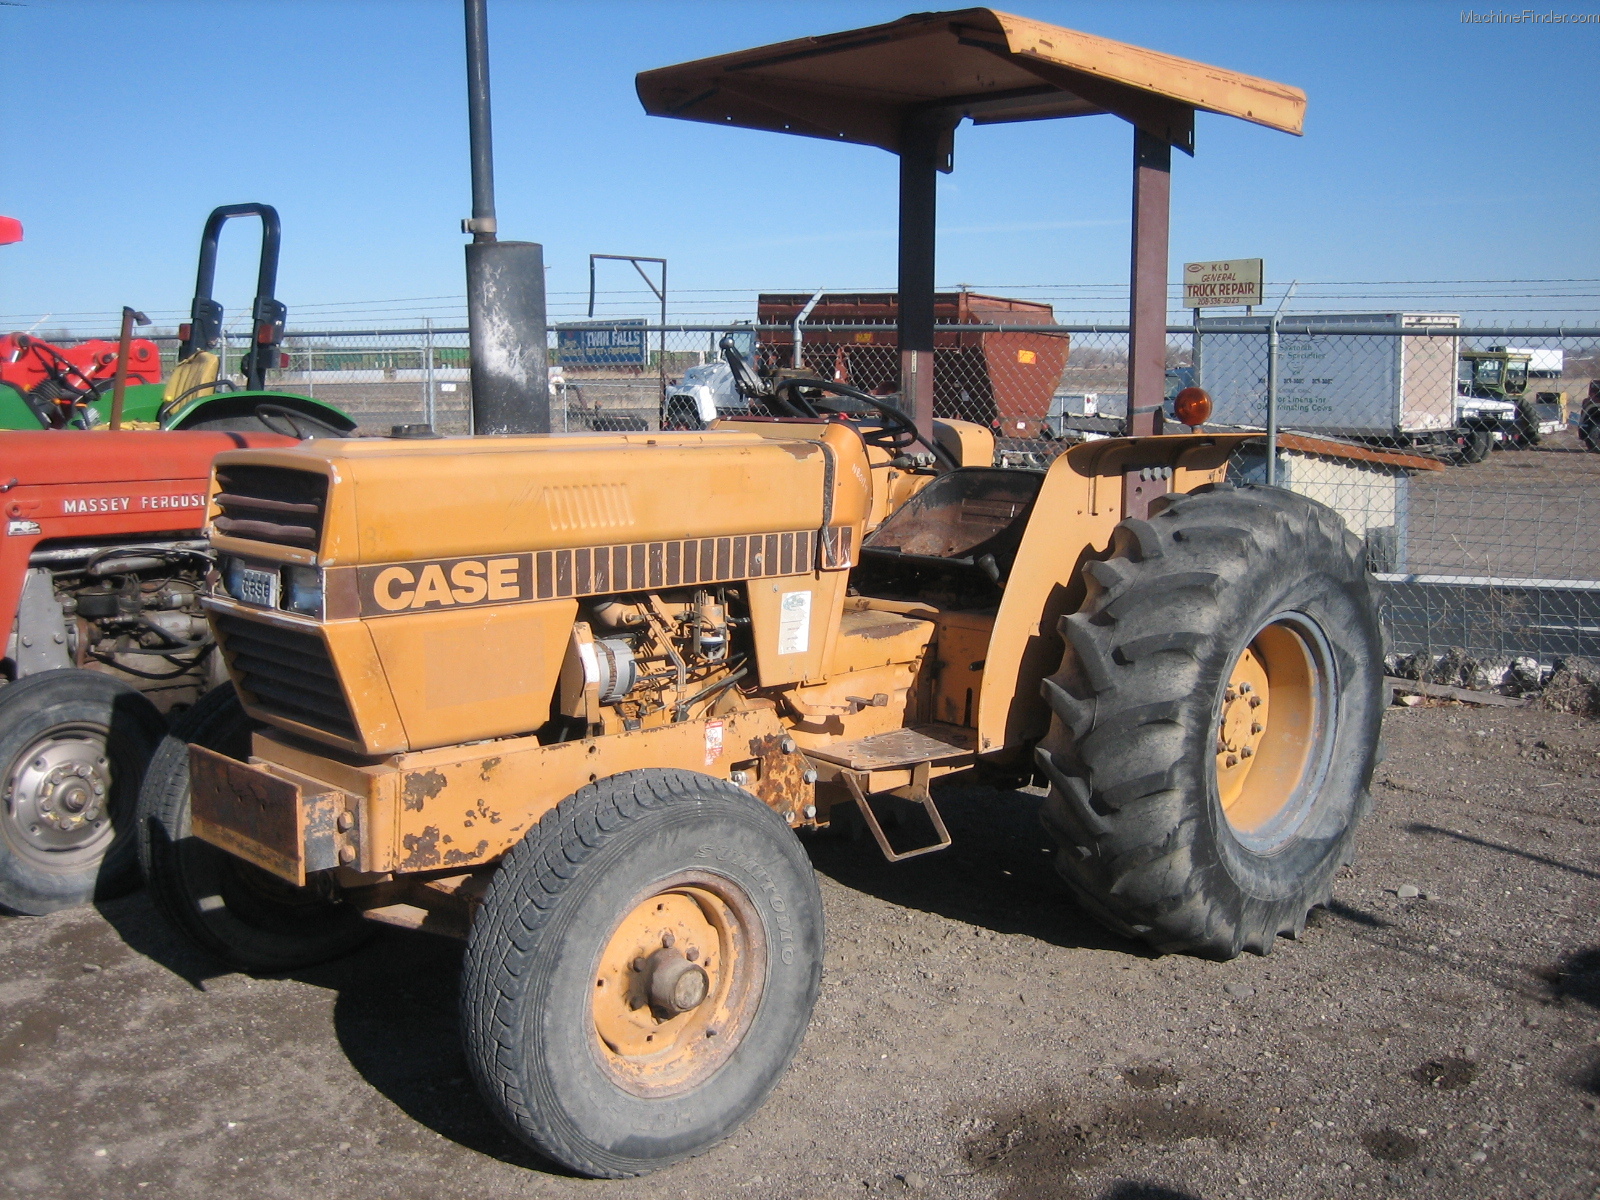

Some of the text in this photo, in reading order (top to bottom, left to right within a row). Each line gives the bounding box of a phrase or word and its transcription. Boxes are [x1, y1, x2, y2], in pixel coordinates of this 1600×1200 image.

[1224, 263, 1230, 271] D
[1201, 272, 1237, 283] GENERAL
[1187, 281, 1255, 298] TRUCK REPAIR
[585, 331, 610, 347] TWIN
[612, 330, 641, 346] FALLS
[64, 498, 130, 513] MASSEY
[373, 557, 520, 611] CASE
[694, 844, 795, 966] SUMITOMO
